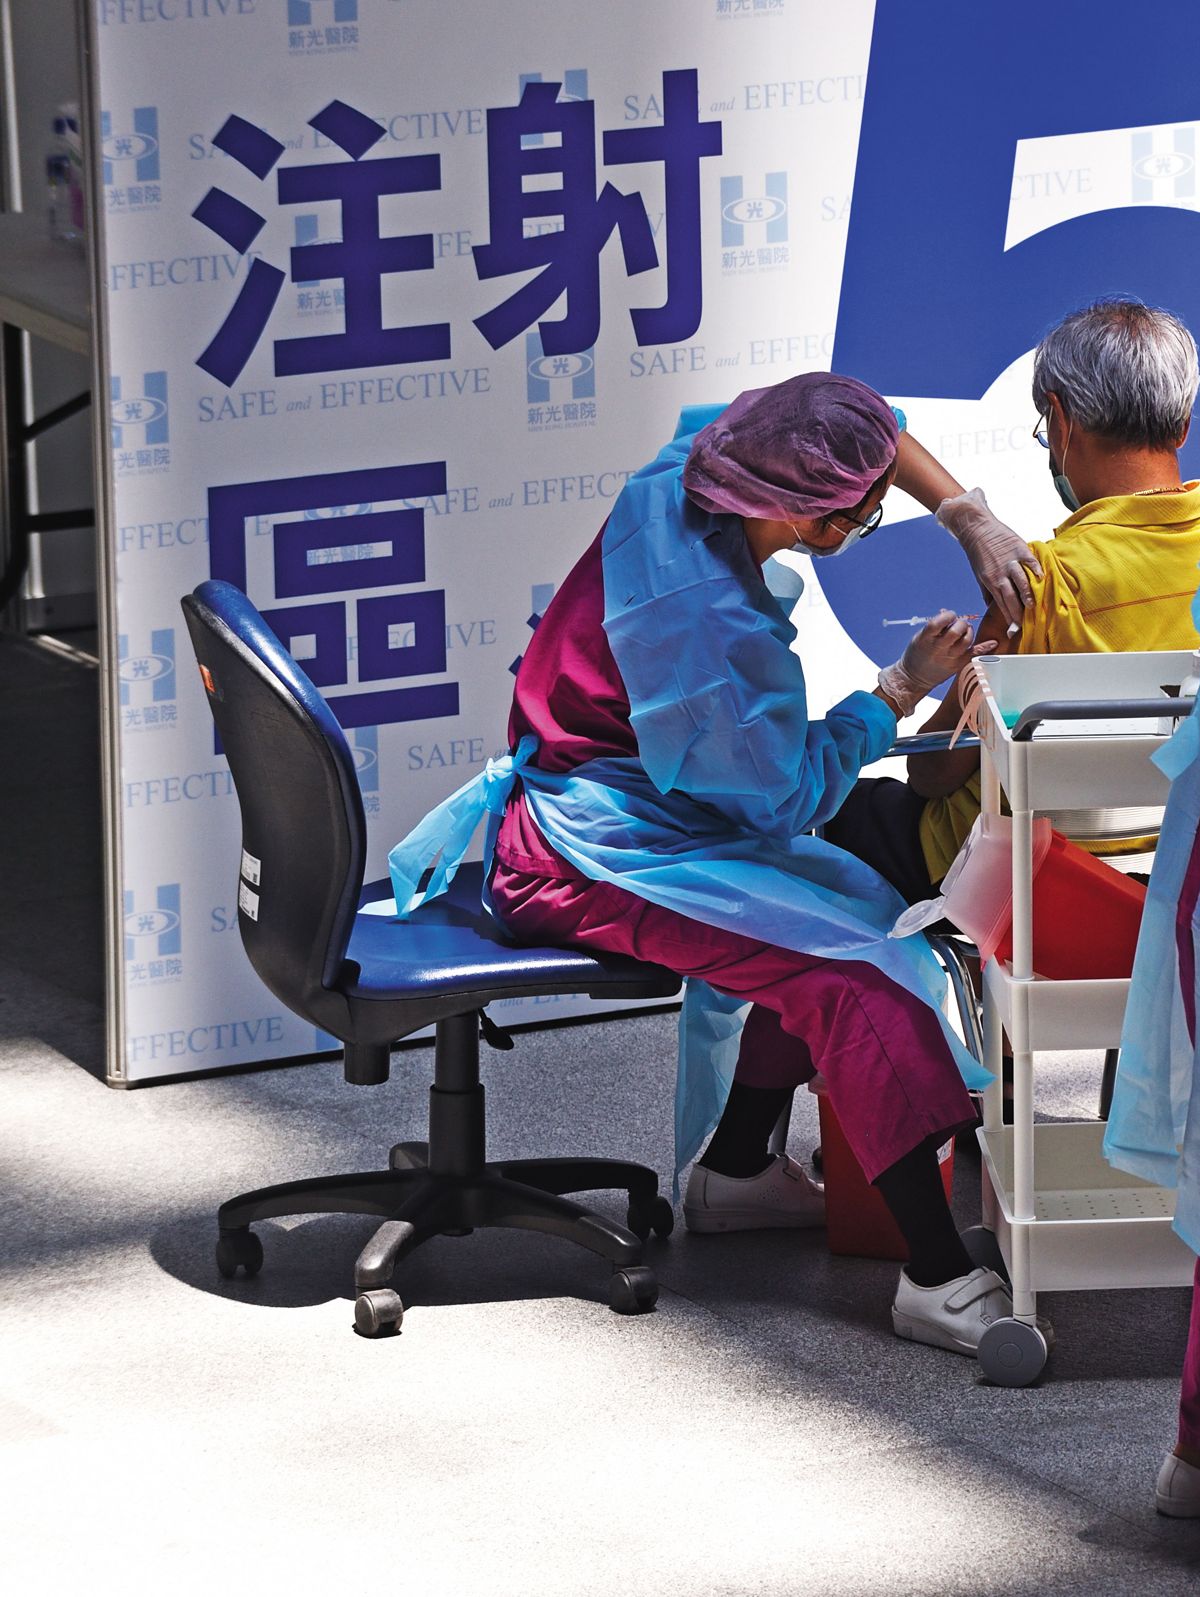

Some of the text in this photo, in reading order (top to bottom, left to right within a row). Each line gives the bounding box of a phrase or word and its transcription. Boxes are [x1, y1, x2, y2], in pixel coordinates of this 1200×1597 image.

[709, 97, 735, 113] and
[191, 67, 723, 388] 注射
[721, 246, 790, 270] 新光醫院
[630, 345, 707, 378] SAFE
[715, 352, 741, 368] and
[198, 367, 491, 423] SAFE and EFFECTIVE
[528, 401, 597, 425] 新光醫院
[939, 424, 1036, 460] EFFEC
[488, 492, 514, 509] and
[207, 461, 459, 756] 區
[408, 738, 486, 771] SAFE
